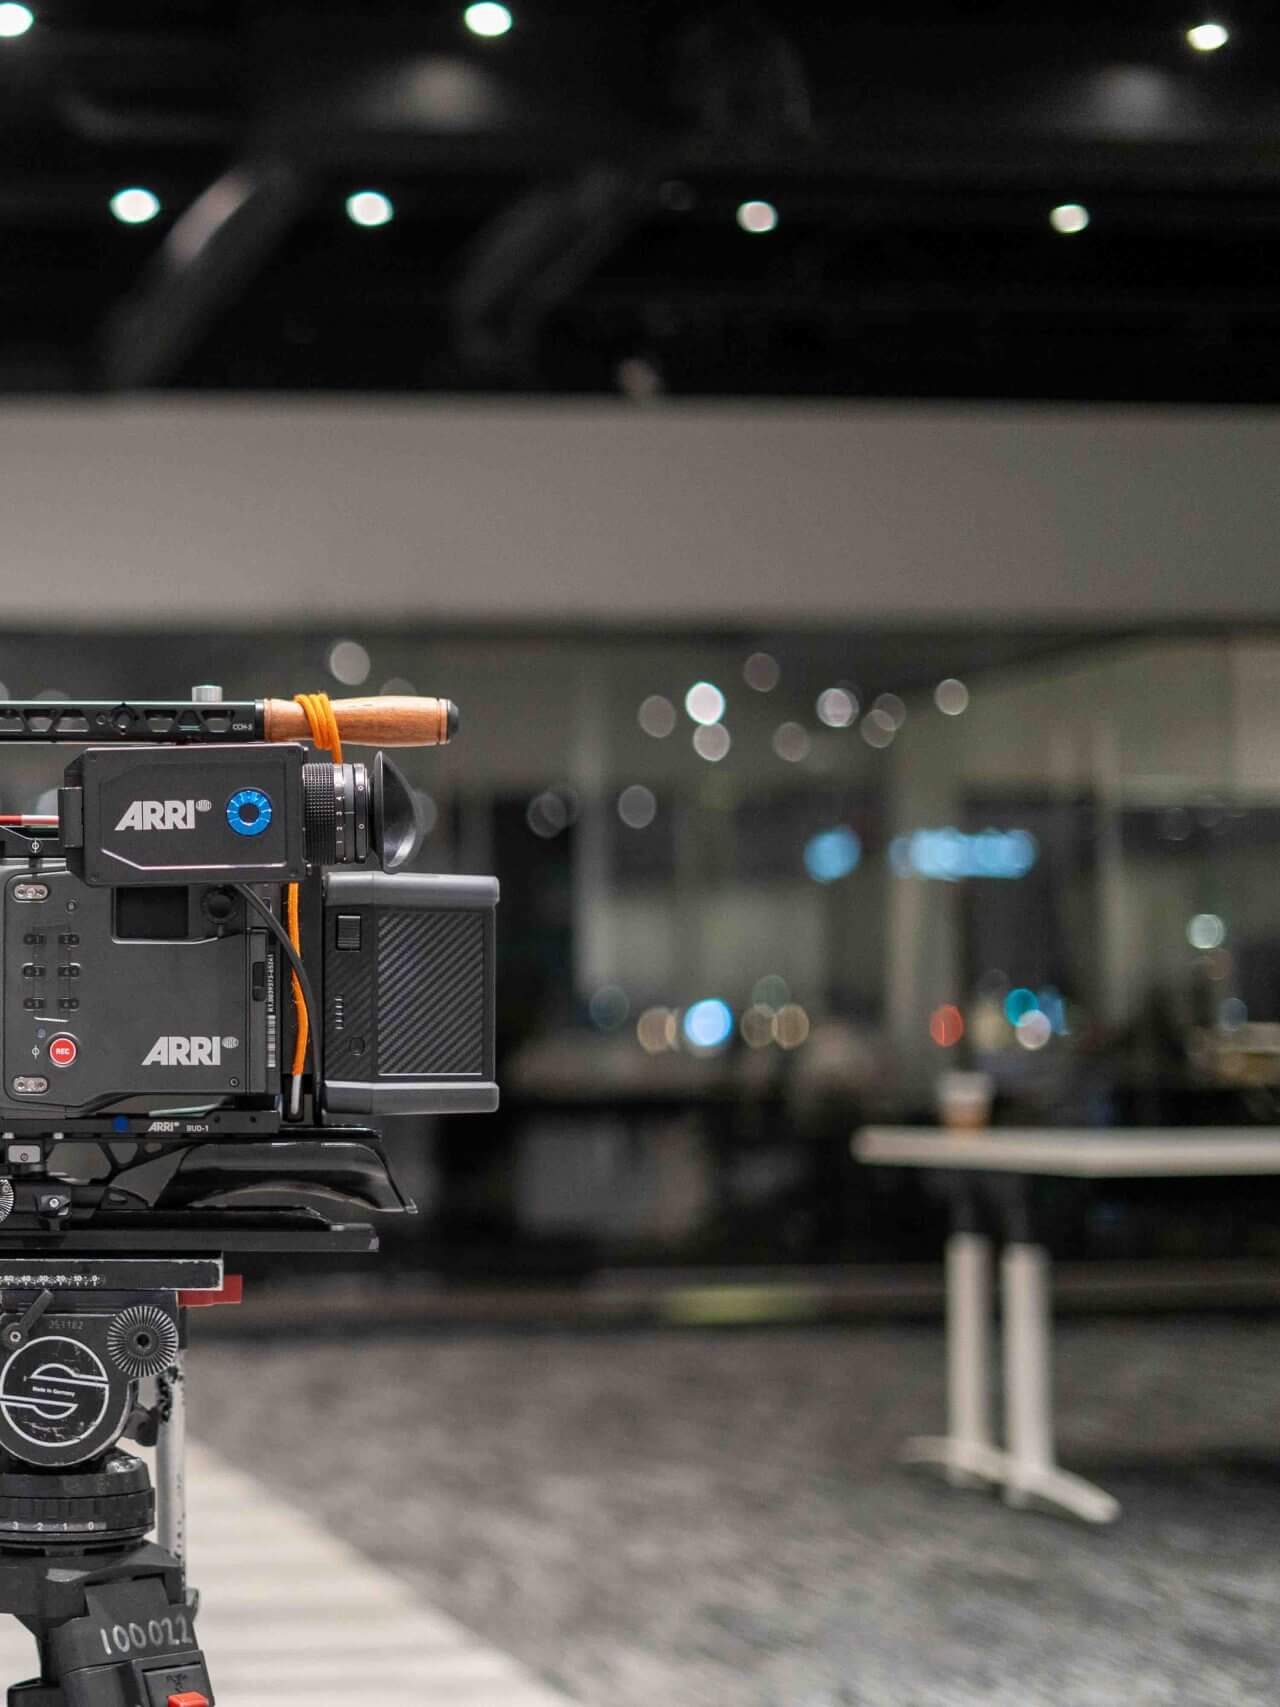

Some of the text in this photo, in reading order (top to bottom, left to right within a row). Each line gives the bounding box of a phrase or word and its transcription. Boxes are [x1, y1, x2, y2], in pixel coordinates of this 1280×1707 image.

[114, 800, 195, 830] ARRI
[141, 1036, 221, 1065] ARRI
[148, 1121, 174, 1132] ARRI
[12, 1521, 19, 1530] 3
[36, 1522, 44, 1531] 2
[63, 1522, 68, 1531] 1
[87, 1521, 95, 1531] 0
[100, 1614, 192, 1655] 100022
